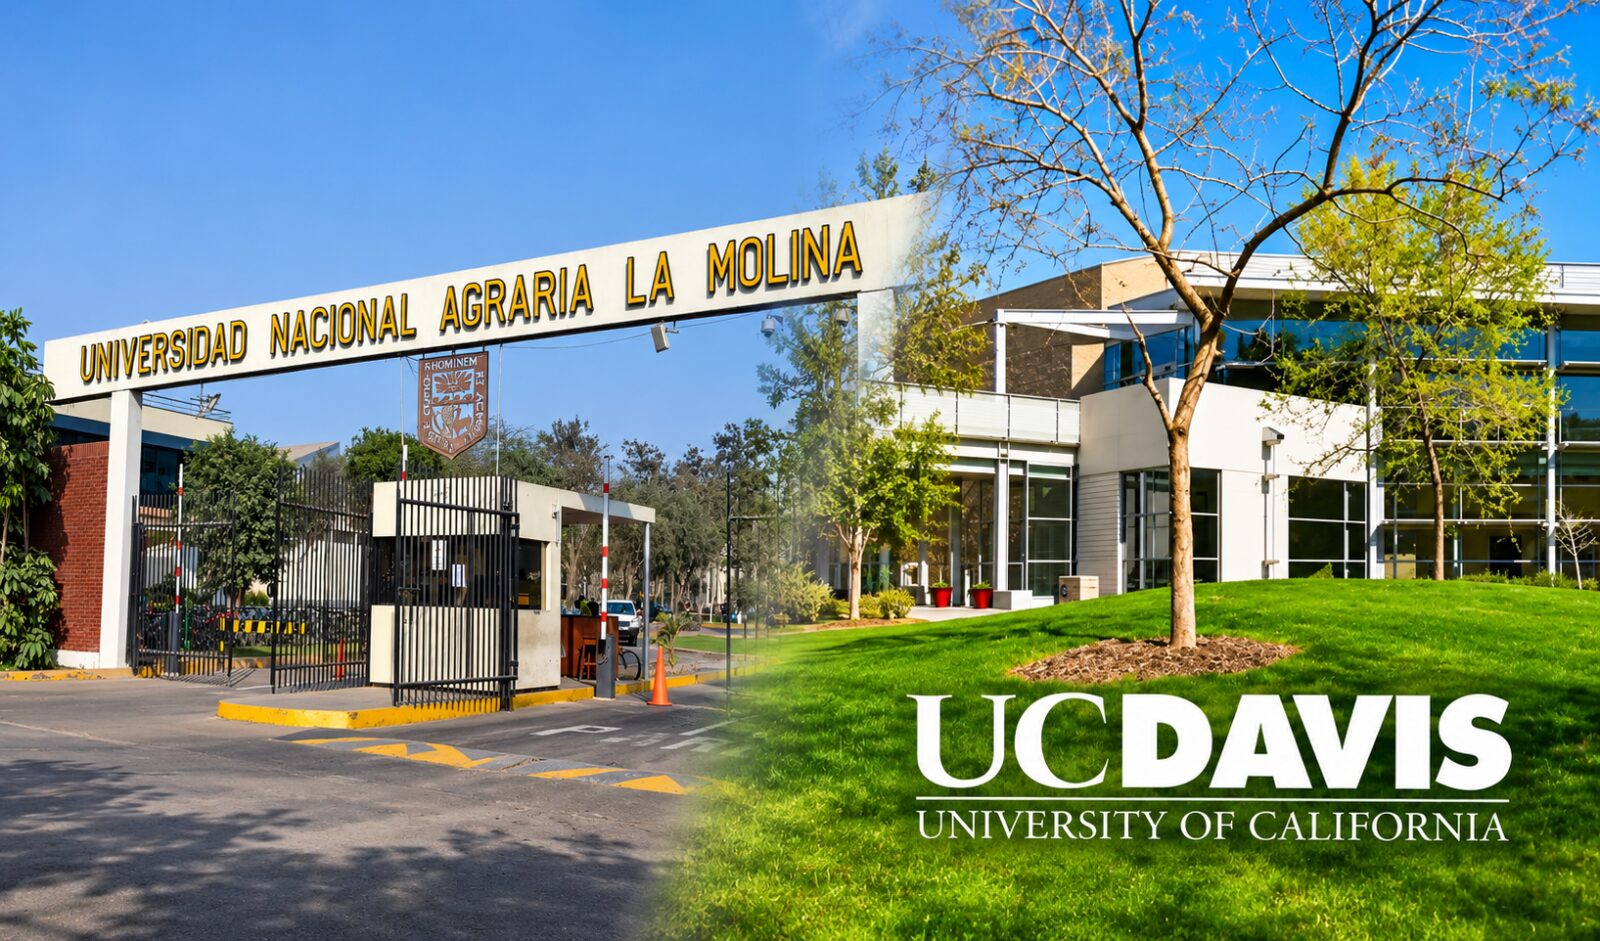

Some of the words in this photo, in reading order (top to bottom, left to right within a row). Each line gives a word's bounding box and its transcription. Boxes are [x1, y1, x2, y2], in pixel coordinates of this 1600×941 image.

[80, 319, 248, 384] UNIVERSIDAD
[270, 293, 417, 357] NACIONAL
[439, 264, 593, 334] AGRARIA
[626, 250, 675, 307] LA
[707, 220, 864, 294] MOLINA
[431, 356, 478, 371] HOMINEM
